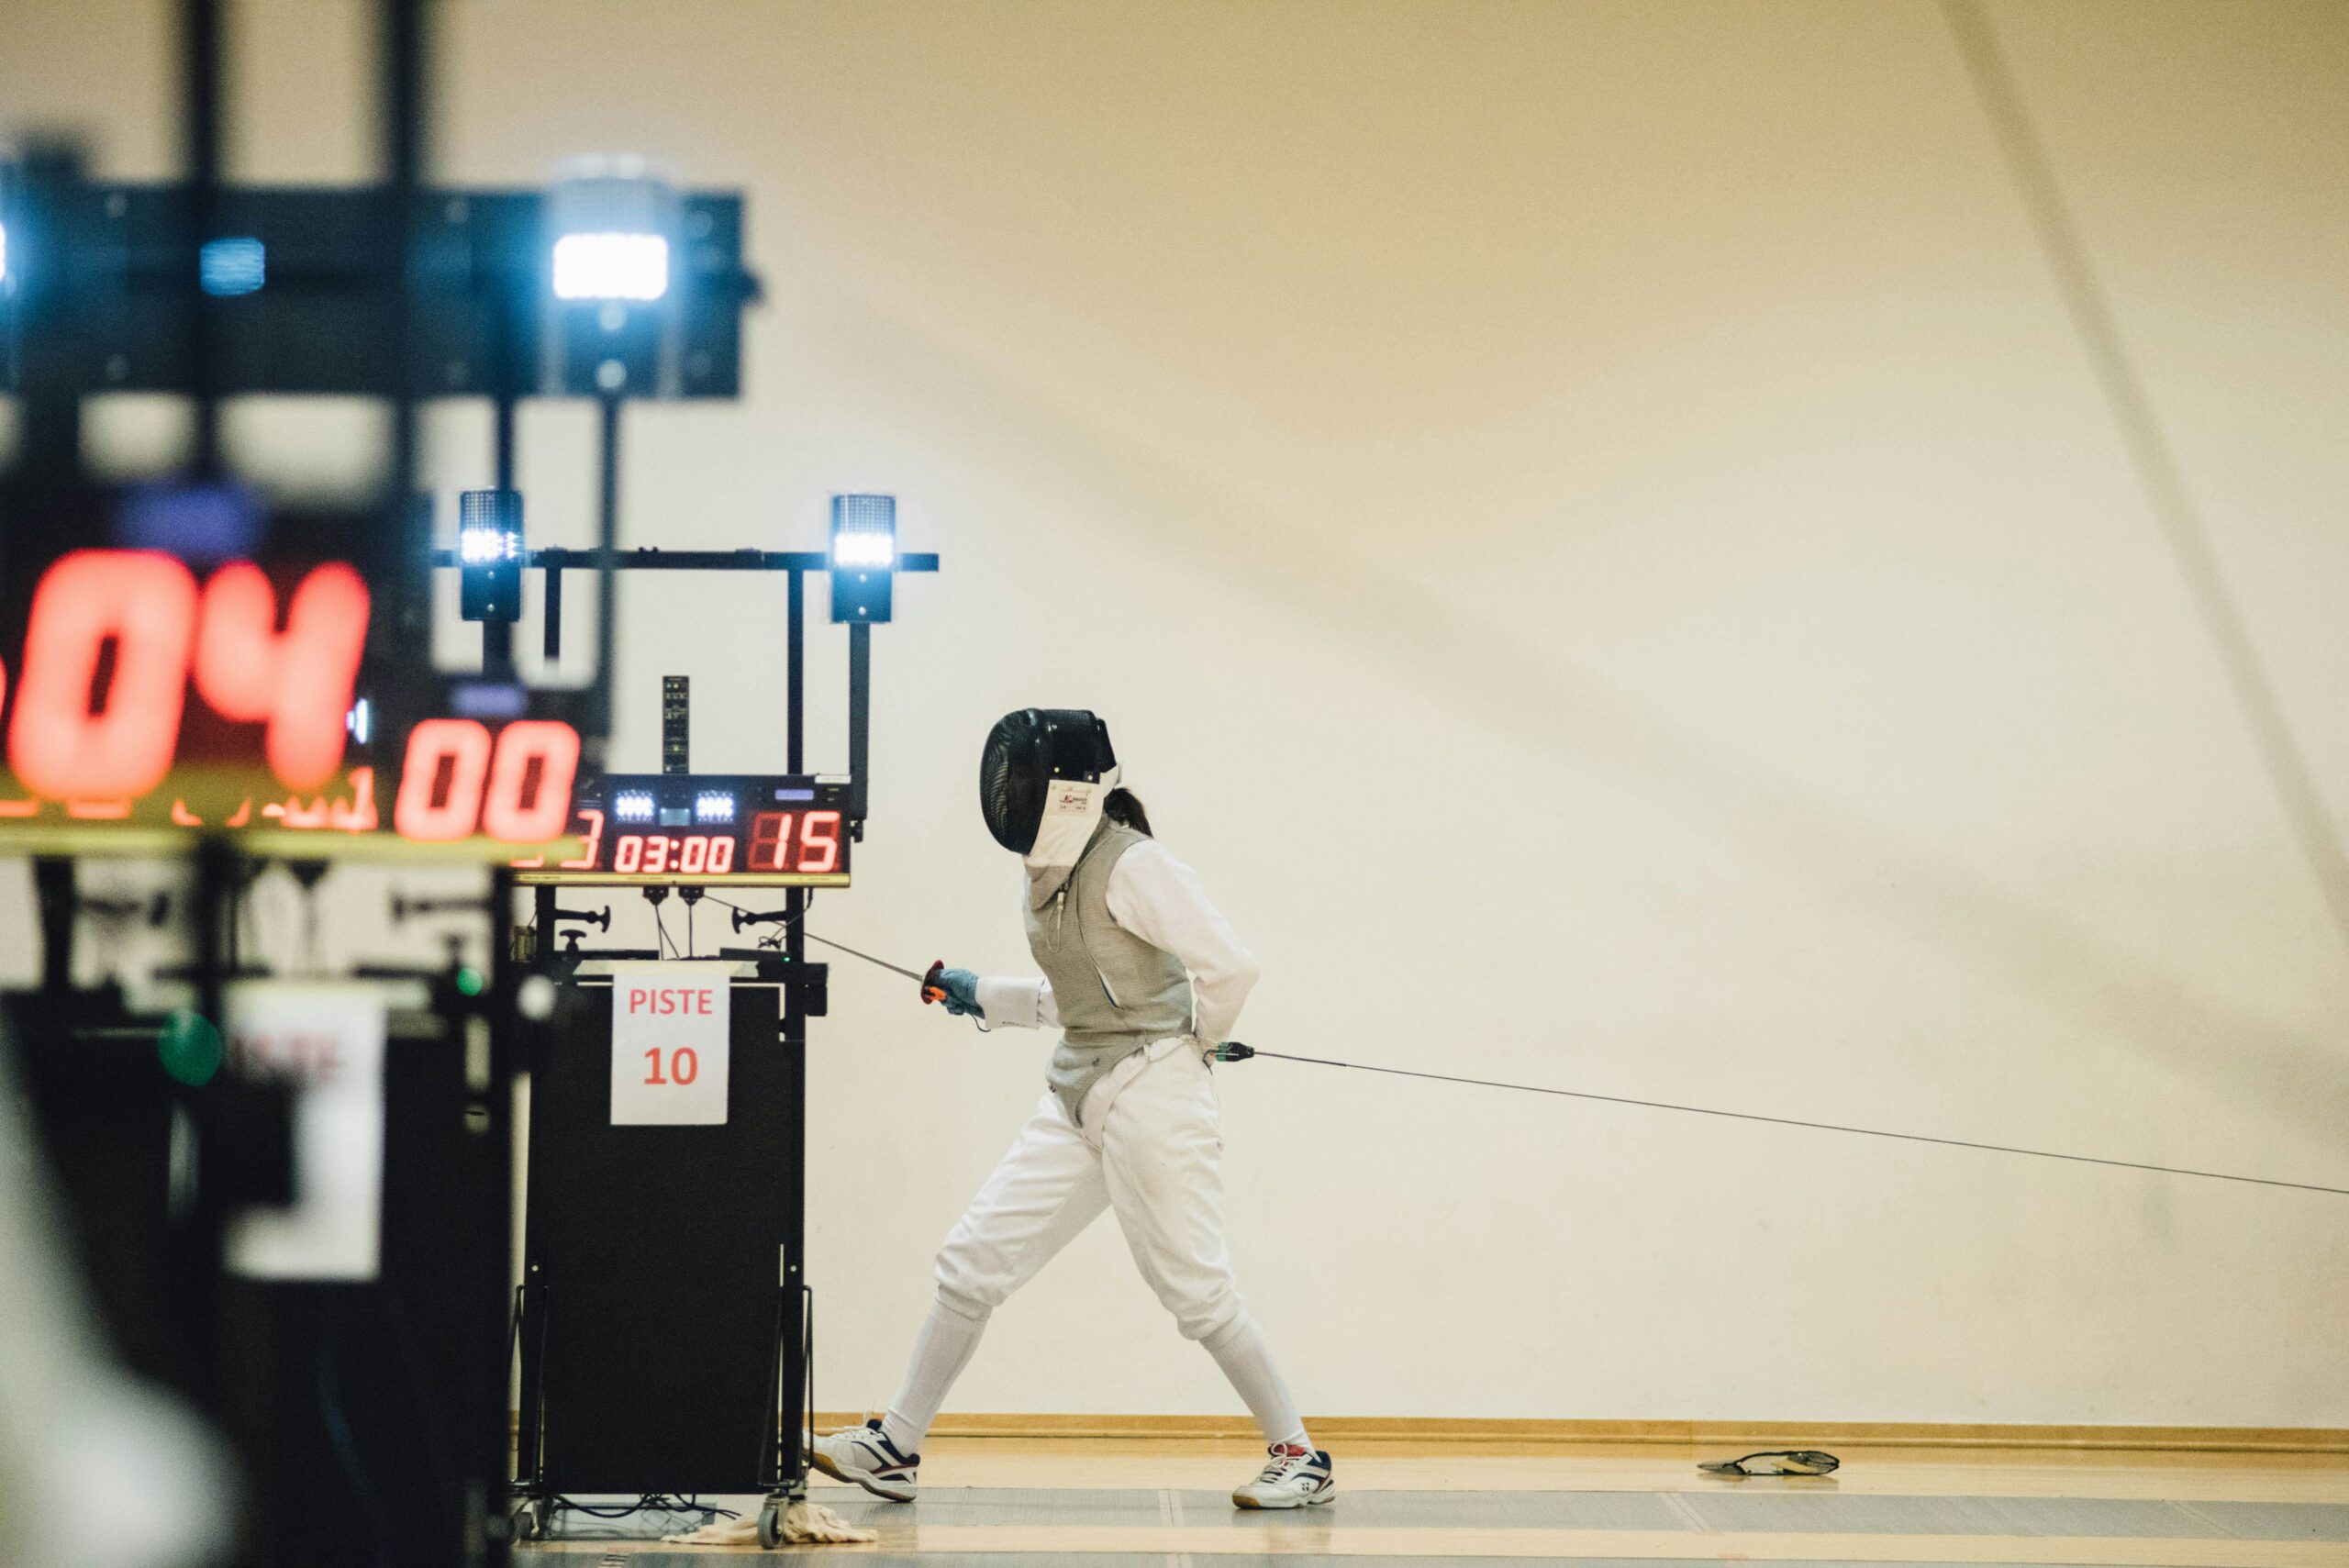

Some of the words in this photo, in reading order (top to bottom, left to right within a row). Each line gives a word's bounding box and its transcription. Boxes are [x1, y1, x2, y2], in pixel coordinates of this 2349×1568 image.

[9, 549, 370, 800] 04
[395, 719, 580, 842] 00
[614, 835, 735, 873] 03:00
[773, 811, 841, 872] 15
[629, 989, 713, 1015] PISTE
[644, 1047, 698, 1085] 10
